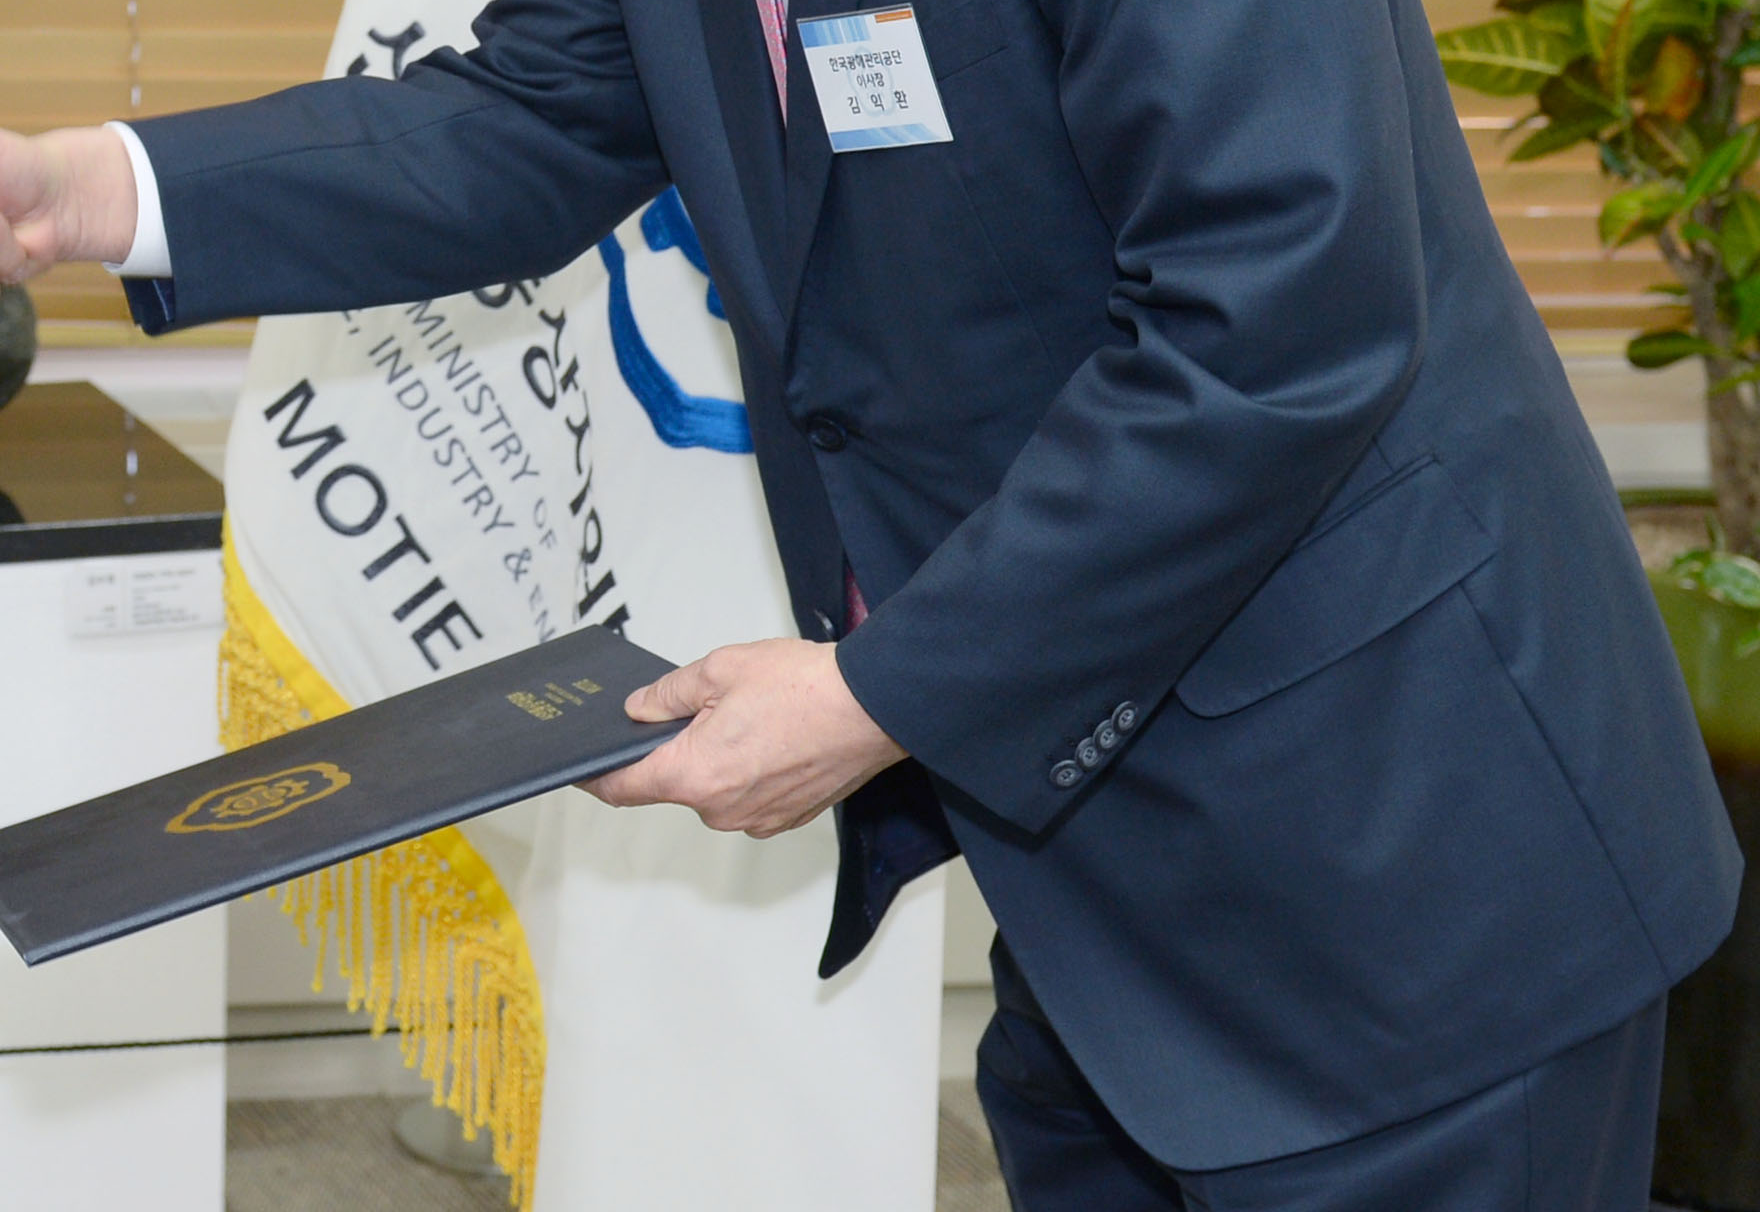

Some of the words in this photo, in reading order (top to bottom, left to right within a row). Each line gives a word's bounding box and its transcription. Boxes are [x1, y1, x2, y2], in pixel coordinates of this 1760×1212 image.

[856, 72, 885, 89] 이사장
[263, 378, 483, 671] MOTIE
[368, 334, 515, 536] INDUSTRY
[504, 548, 532, 584] &
[405, 300, 540, 481] MINISTRY
[534, 497, 557, 550] OF
